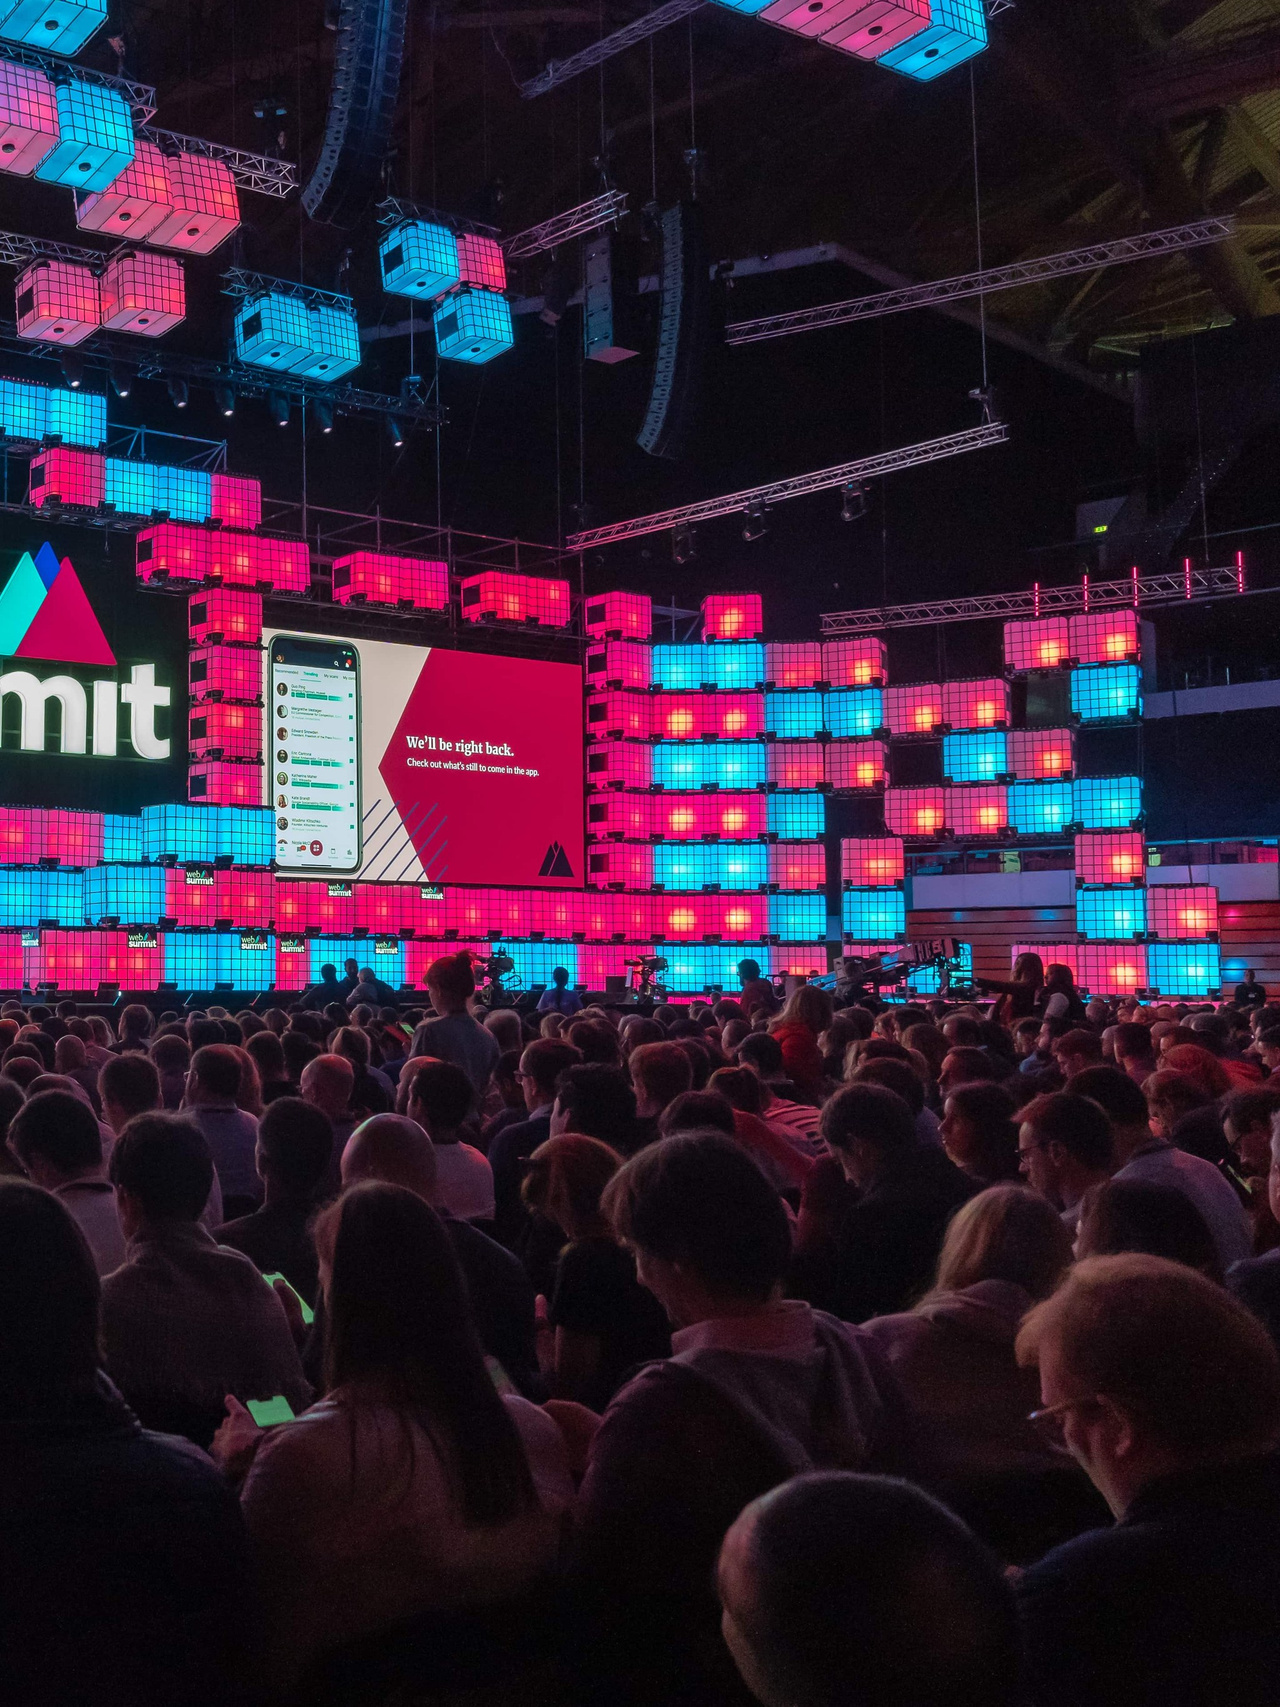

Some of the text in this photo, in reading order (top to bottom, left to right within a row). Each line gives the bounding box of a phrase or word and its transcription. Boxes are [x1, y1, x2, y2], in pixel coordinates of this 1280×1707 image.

[439, 738, 452, 751] be
[455, 740, 483, 756] right
[485, 742, 514, 756] back.
[407, 758, 428, 768] Check
[430, 760, 442, 769] out
[466, 763, 478, 772] still
[479, 764, 486, 772] to
[487, 766, 505, 774] come
[506, 765, 513, 774] in
[514, 766, 524, 775] the
[525, 768, 539, 777] app.
[186, 870, 200, 878] web
[186, 877, 214, 885] summit
[128, 933, 143, 941] web
[241, 935, 255, 943] web
[128, 940, 157, 948] summit
[241, 942, 268, 950] summit
[281, 939, 294, 947] web
[281, 945, 305, 953] summit
